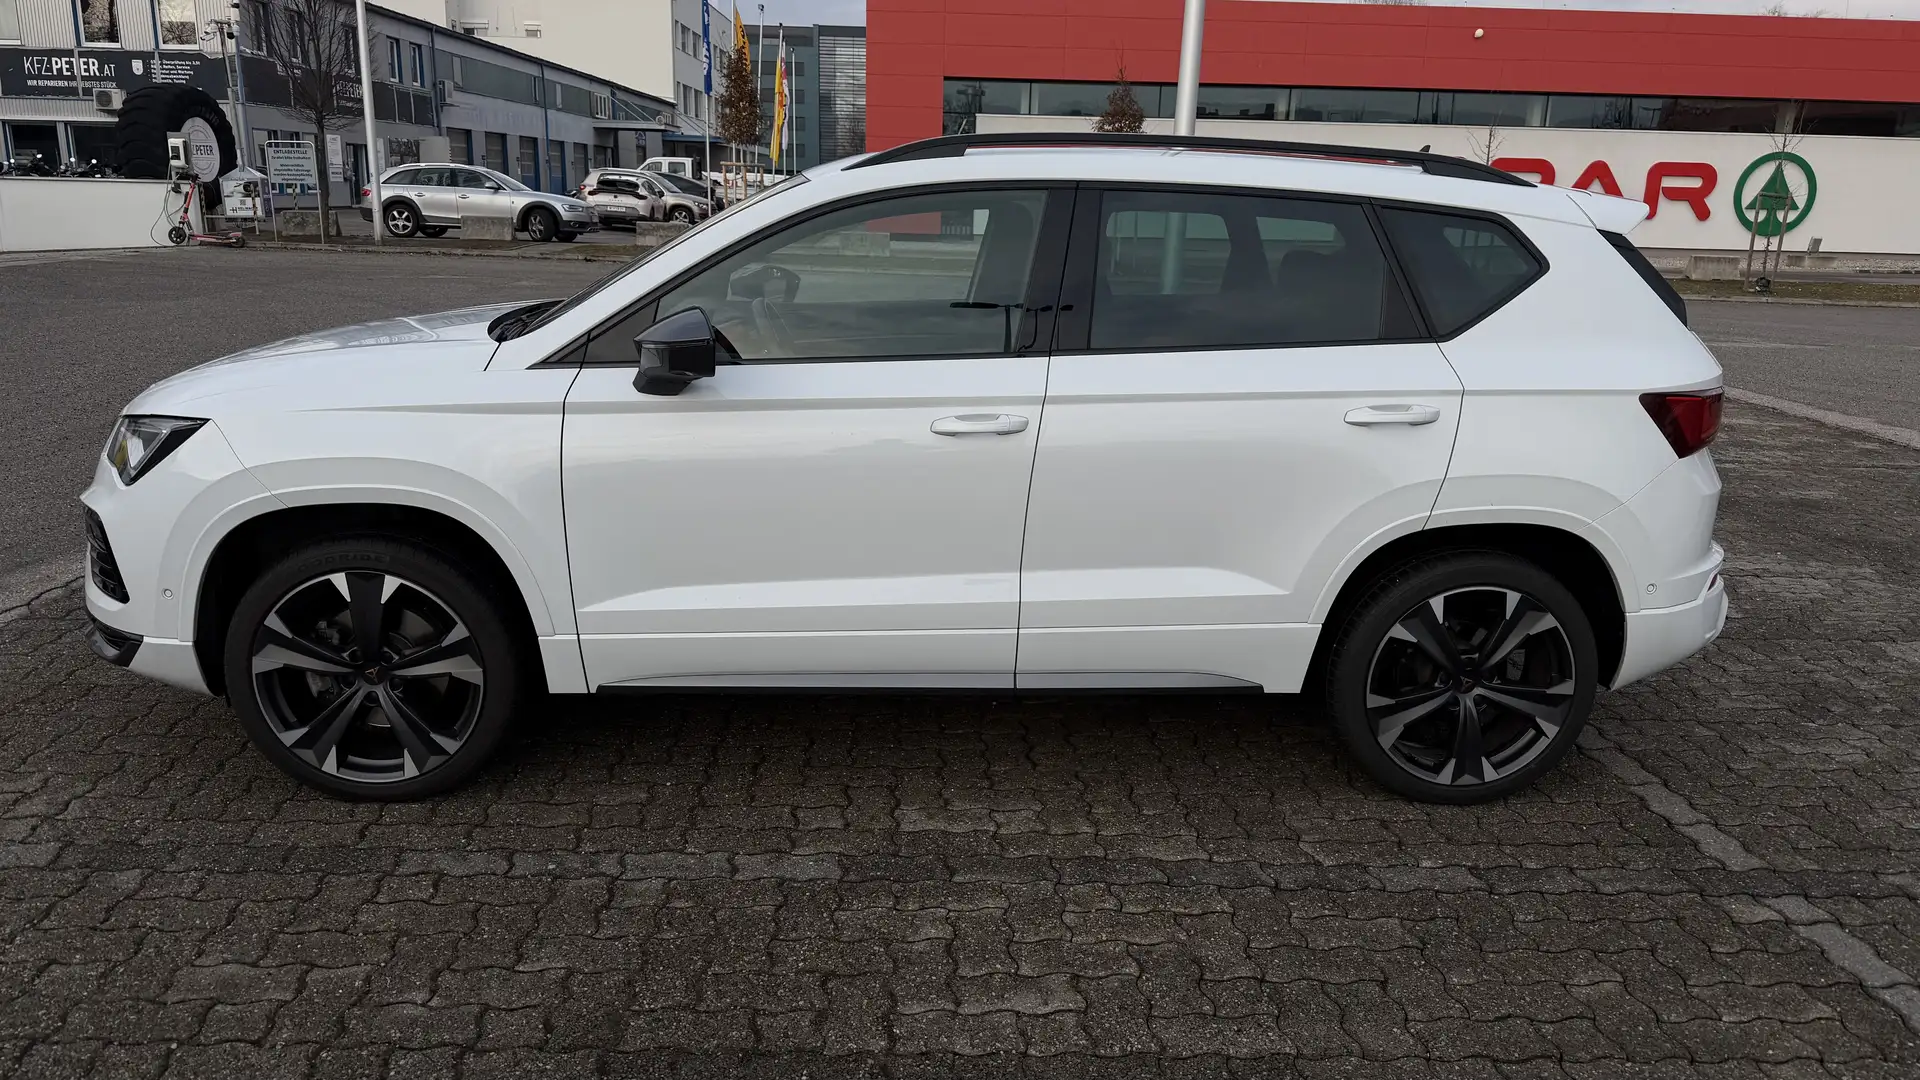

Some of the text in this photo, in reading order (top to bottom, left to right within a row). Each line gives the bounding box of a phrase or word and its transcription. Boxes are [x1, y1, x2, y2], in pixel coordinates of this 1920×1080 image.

[26, 79, 37, 87] WIR
[38, 80, 68, 88] REPARIEREN
[80, 81, 100, 89] IEBSTES
[1489, 157, 1718, 222] AR
